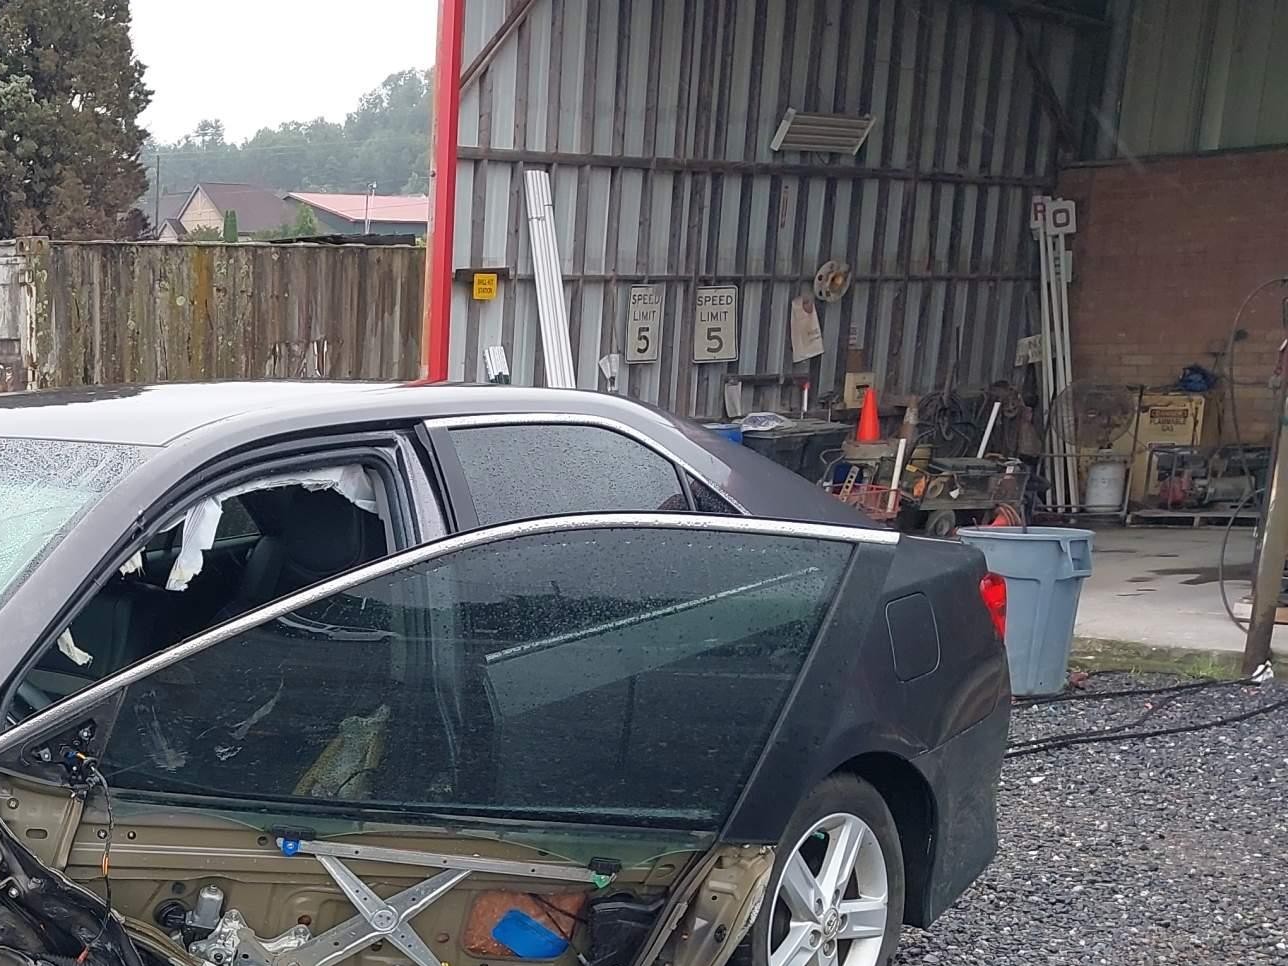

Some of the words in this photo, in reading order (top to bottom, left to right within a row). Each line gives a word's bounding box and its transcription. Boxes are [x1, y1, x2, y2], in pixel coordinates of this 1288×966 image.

[632, 294, 662, 304] SPEED
[697, 295, 732, 306] SPEED
[634, 311, 656, 321] LIMIT
[700, 311, 728, 321] LIMIT
[637, 327, 649, 353] 5
[706, 327, 723, 353] 5
